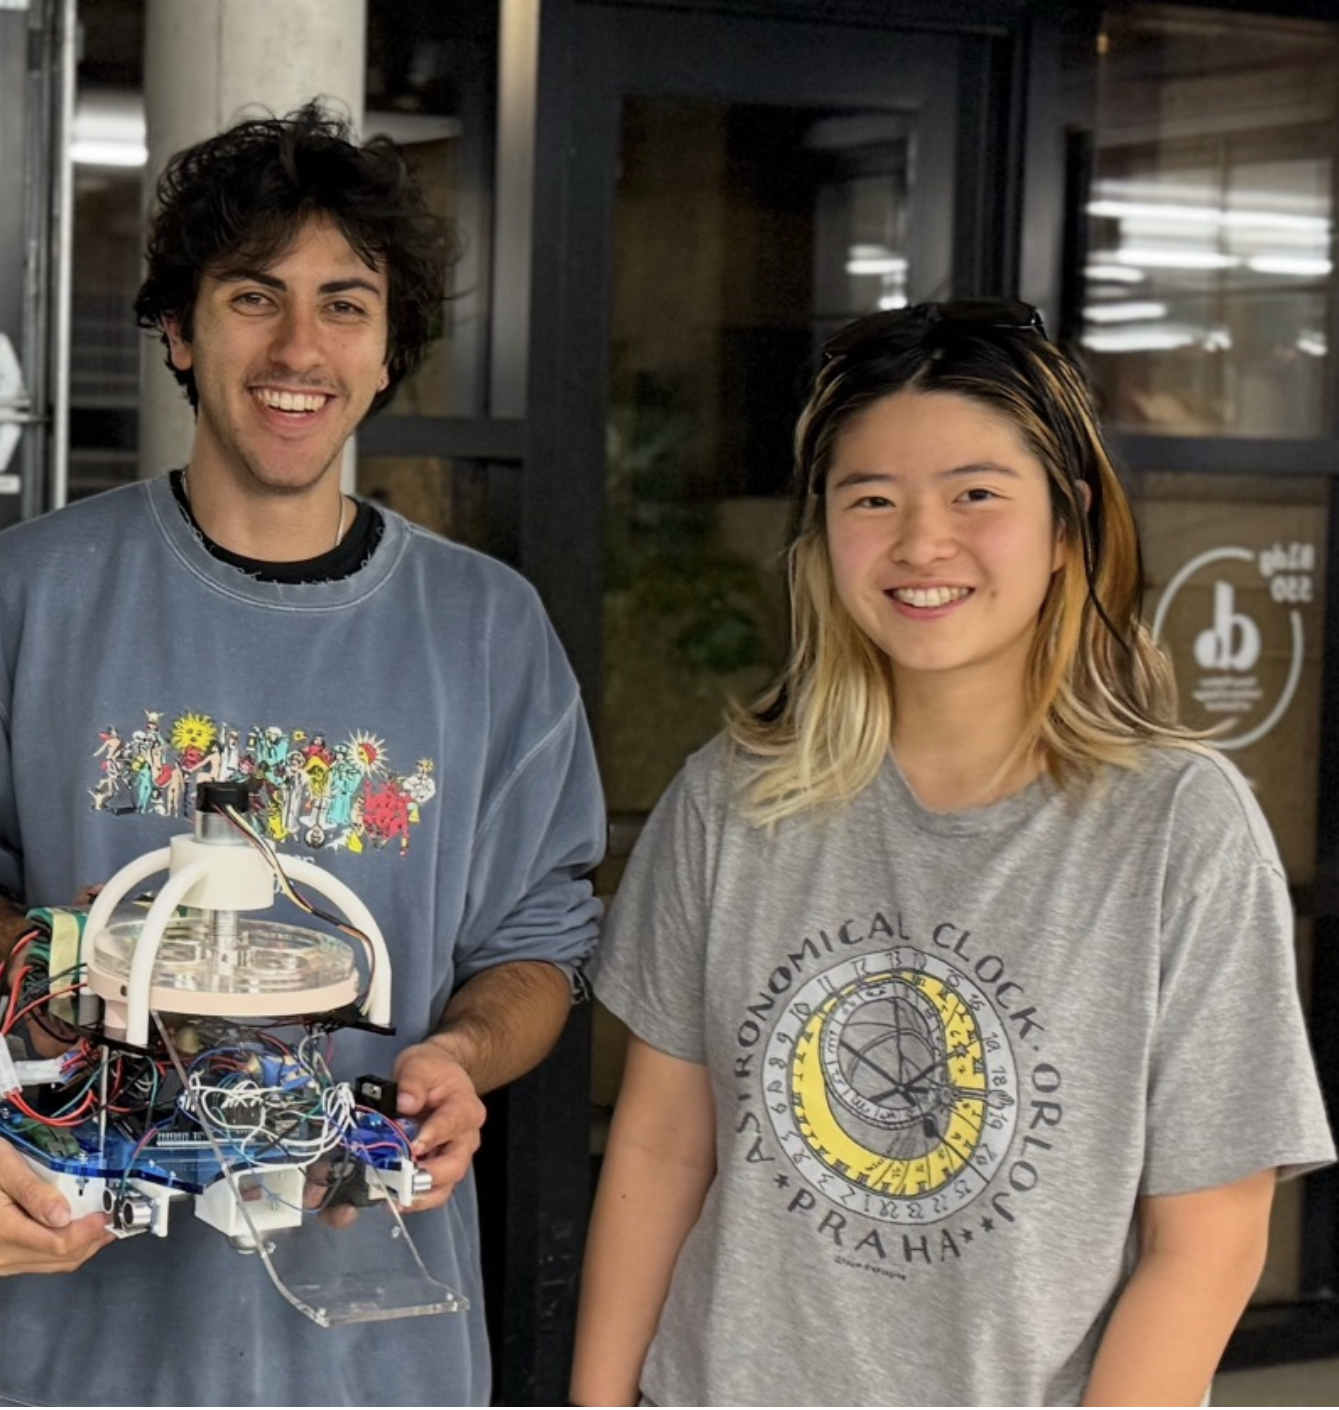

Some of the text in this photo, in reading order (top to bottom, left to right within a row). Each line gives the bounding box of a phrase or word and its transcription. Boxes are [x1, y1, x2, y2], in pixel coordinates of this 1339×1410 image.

[932, 922, 1045, 1039] CLOCK
[992, 1063, 1063, 1223] ORLOJ
[787, 1188, 962, 1264] PRAHA
